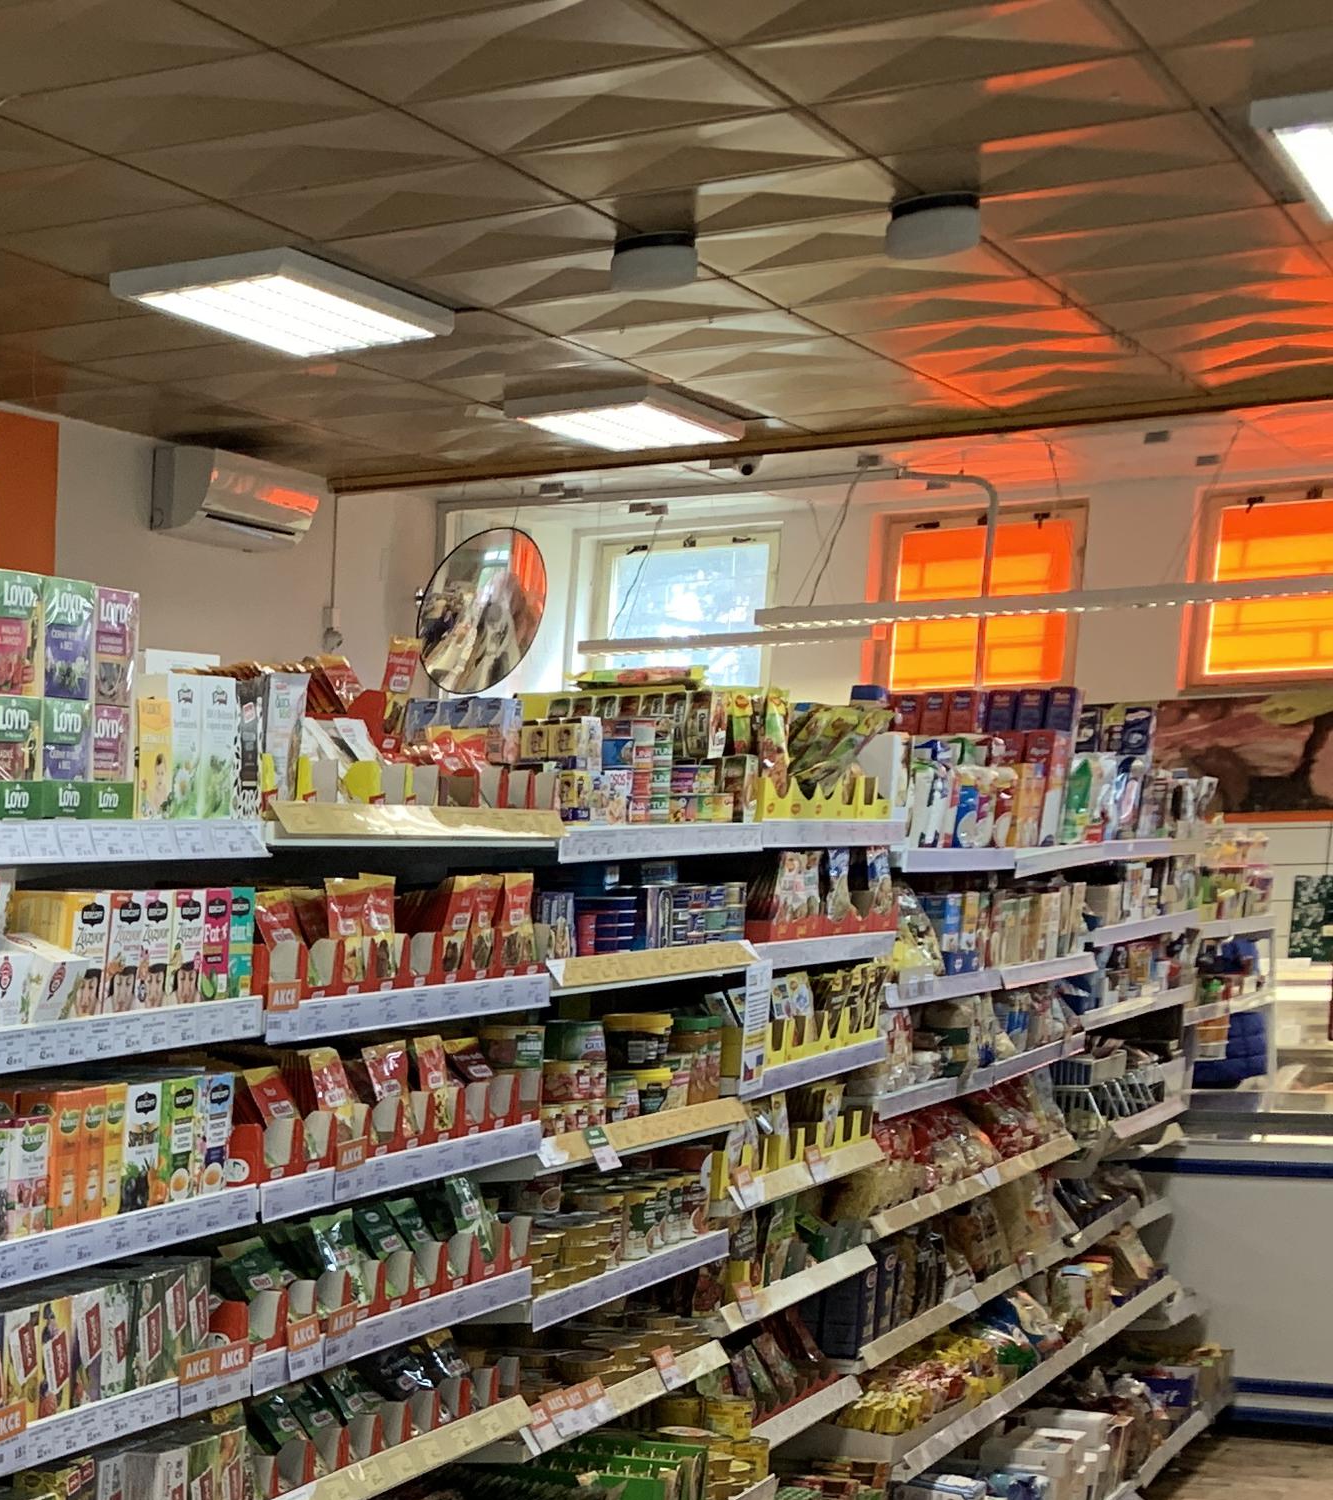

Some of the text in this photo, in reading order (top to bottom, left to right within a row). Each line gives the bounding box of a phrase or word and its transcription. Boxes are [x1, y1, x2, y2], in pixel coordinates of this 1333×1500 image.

[3, 580, 35, 607] LOYD
[100, 596, 128, 625] LOYD
[186, 1358, 210, 1377] AKCE
[220, 1347, 244, 1371] AKCE
